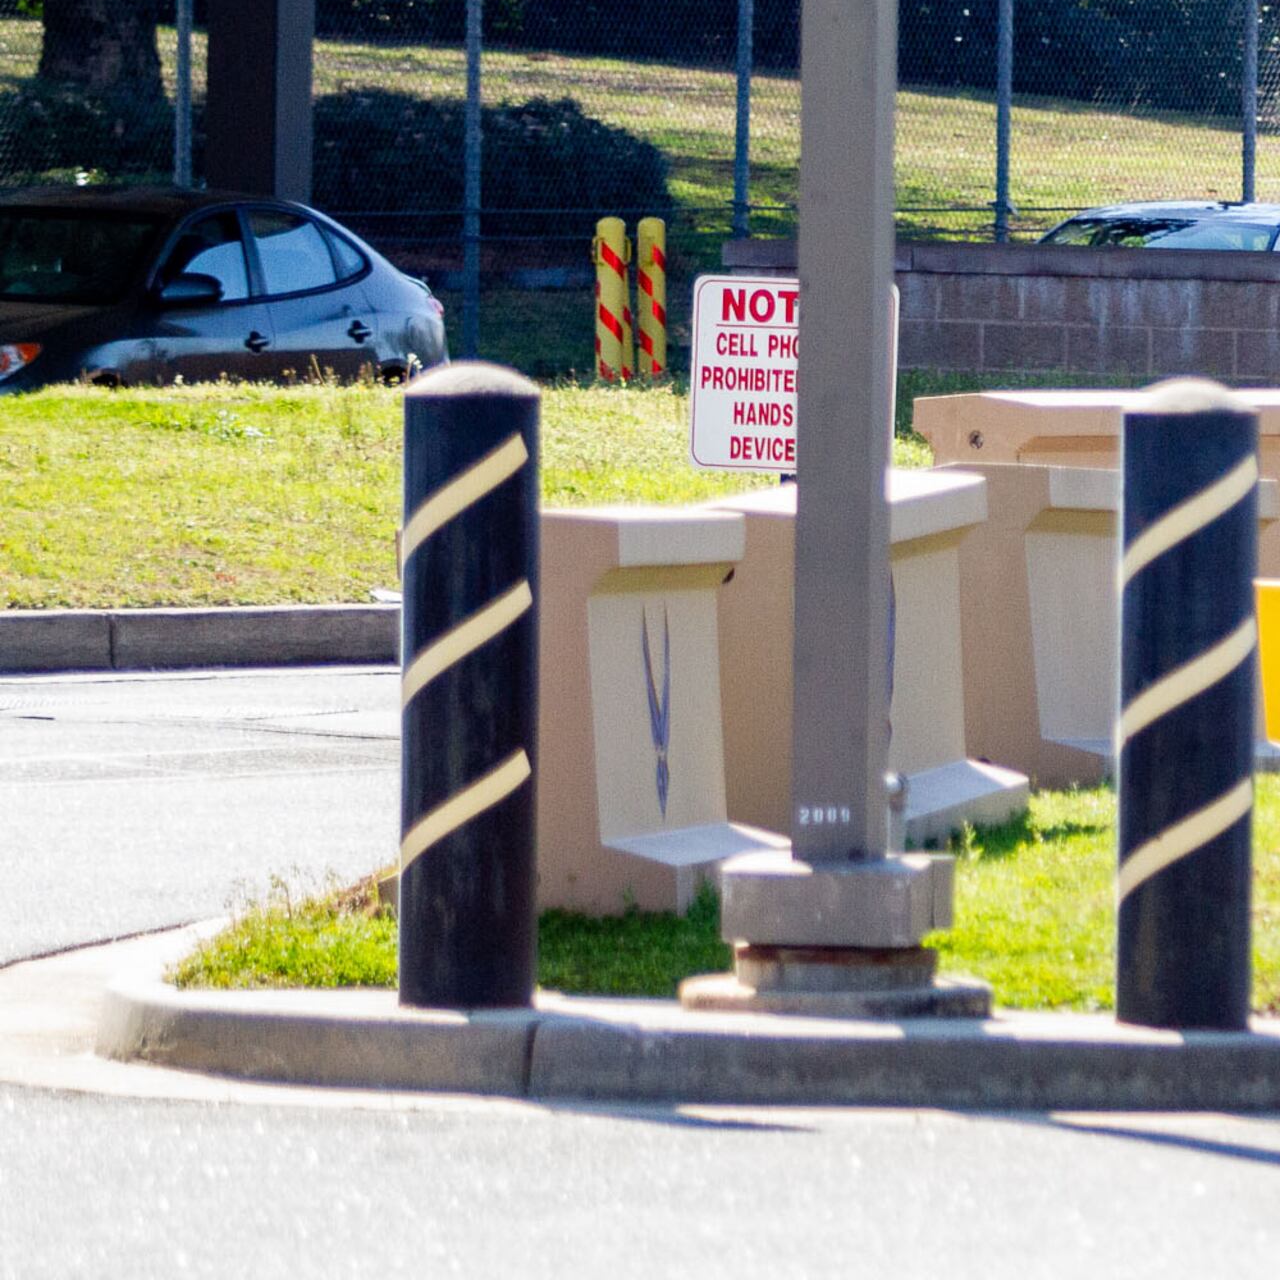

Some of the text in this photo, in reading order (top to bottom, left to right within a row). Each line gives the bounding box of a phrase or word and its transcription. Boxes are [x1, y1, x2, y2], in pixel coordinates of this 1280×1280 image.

[716, 332, 759, 357] CELL
[701, 366, 800, 393] PROHIBITE
[733, 401, 794, 427] HANDS
